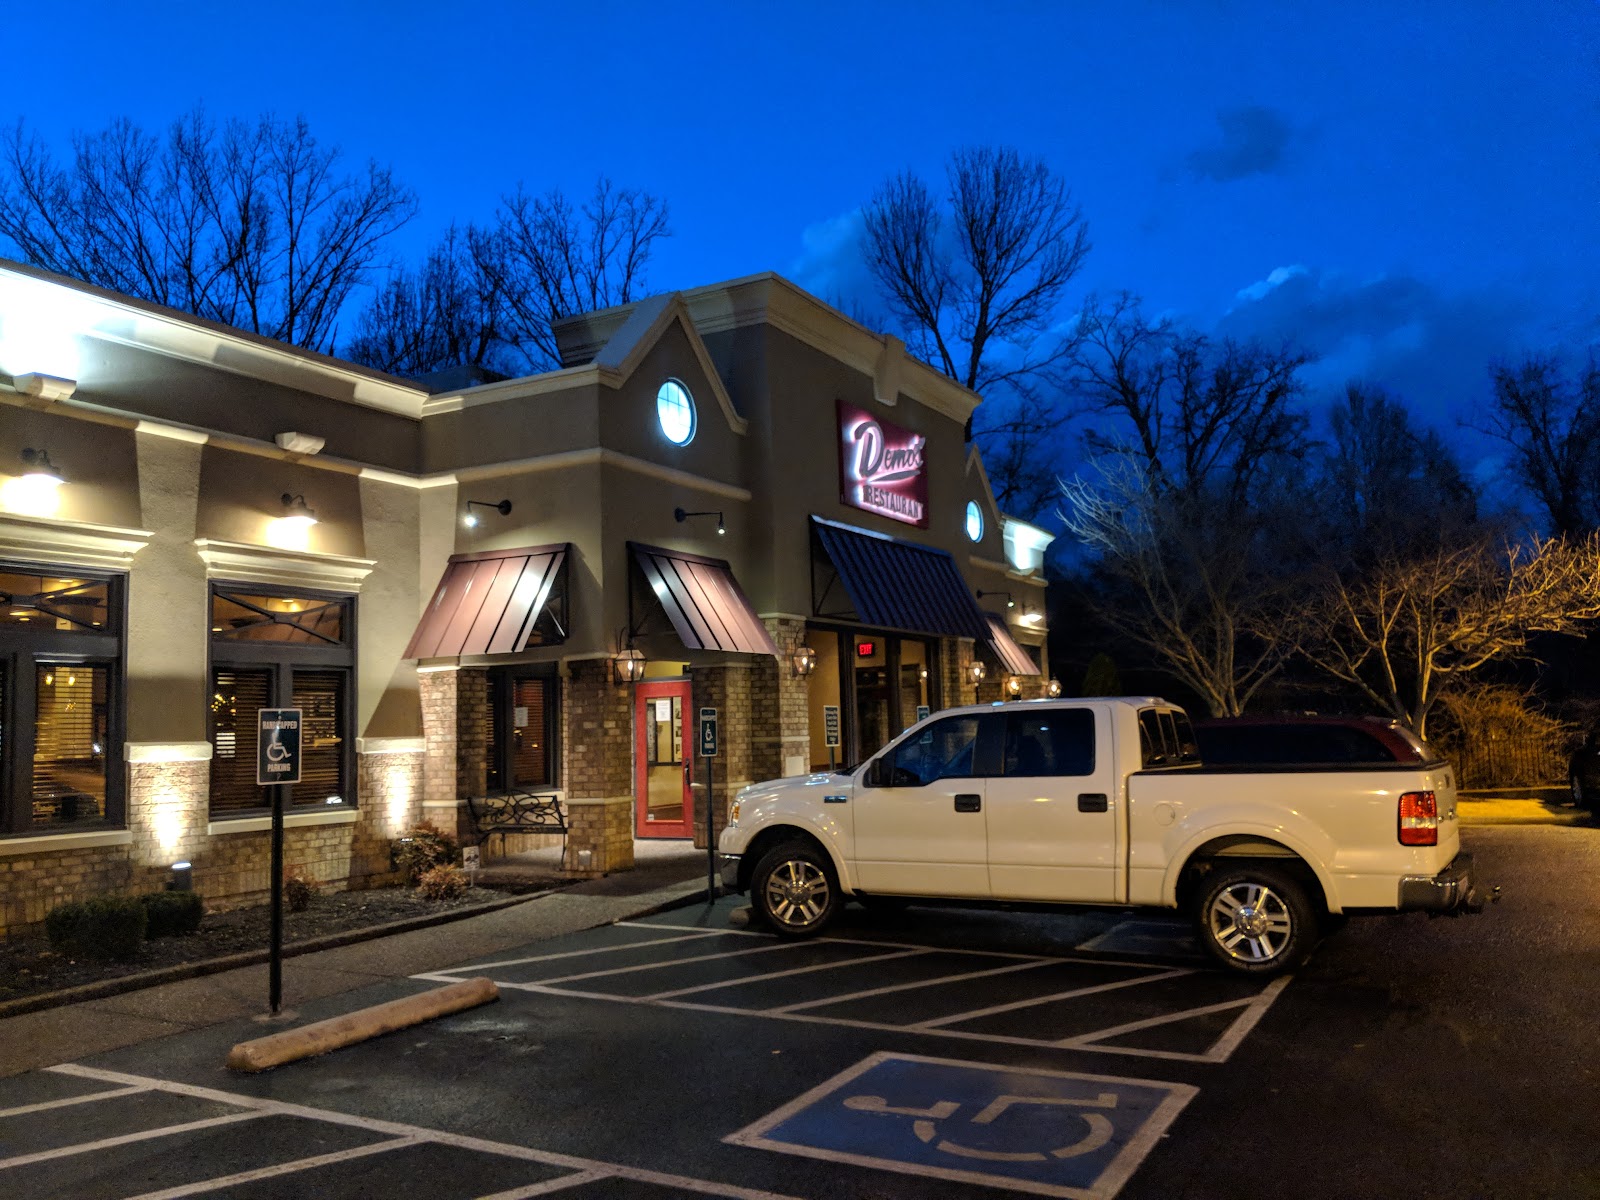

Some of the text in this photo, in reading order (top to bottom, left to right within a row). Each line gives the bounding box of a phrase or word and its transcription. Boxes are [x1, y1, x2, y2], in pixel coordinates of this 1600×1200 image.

[862, 484, 924, 520] RESTAURANT
[859, 643, 873, 655] EXIT
[267, 763, 291, 772] PARKING
